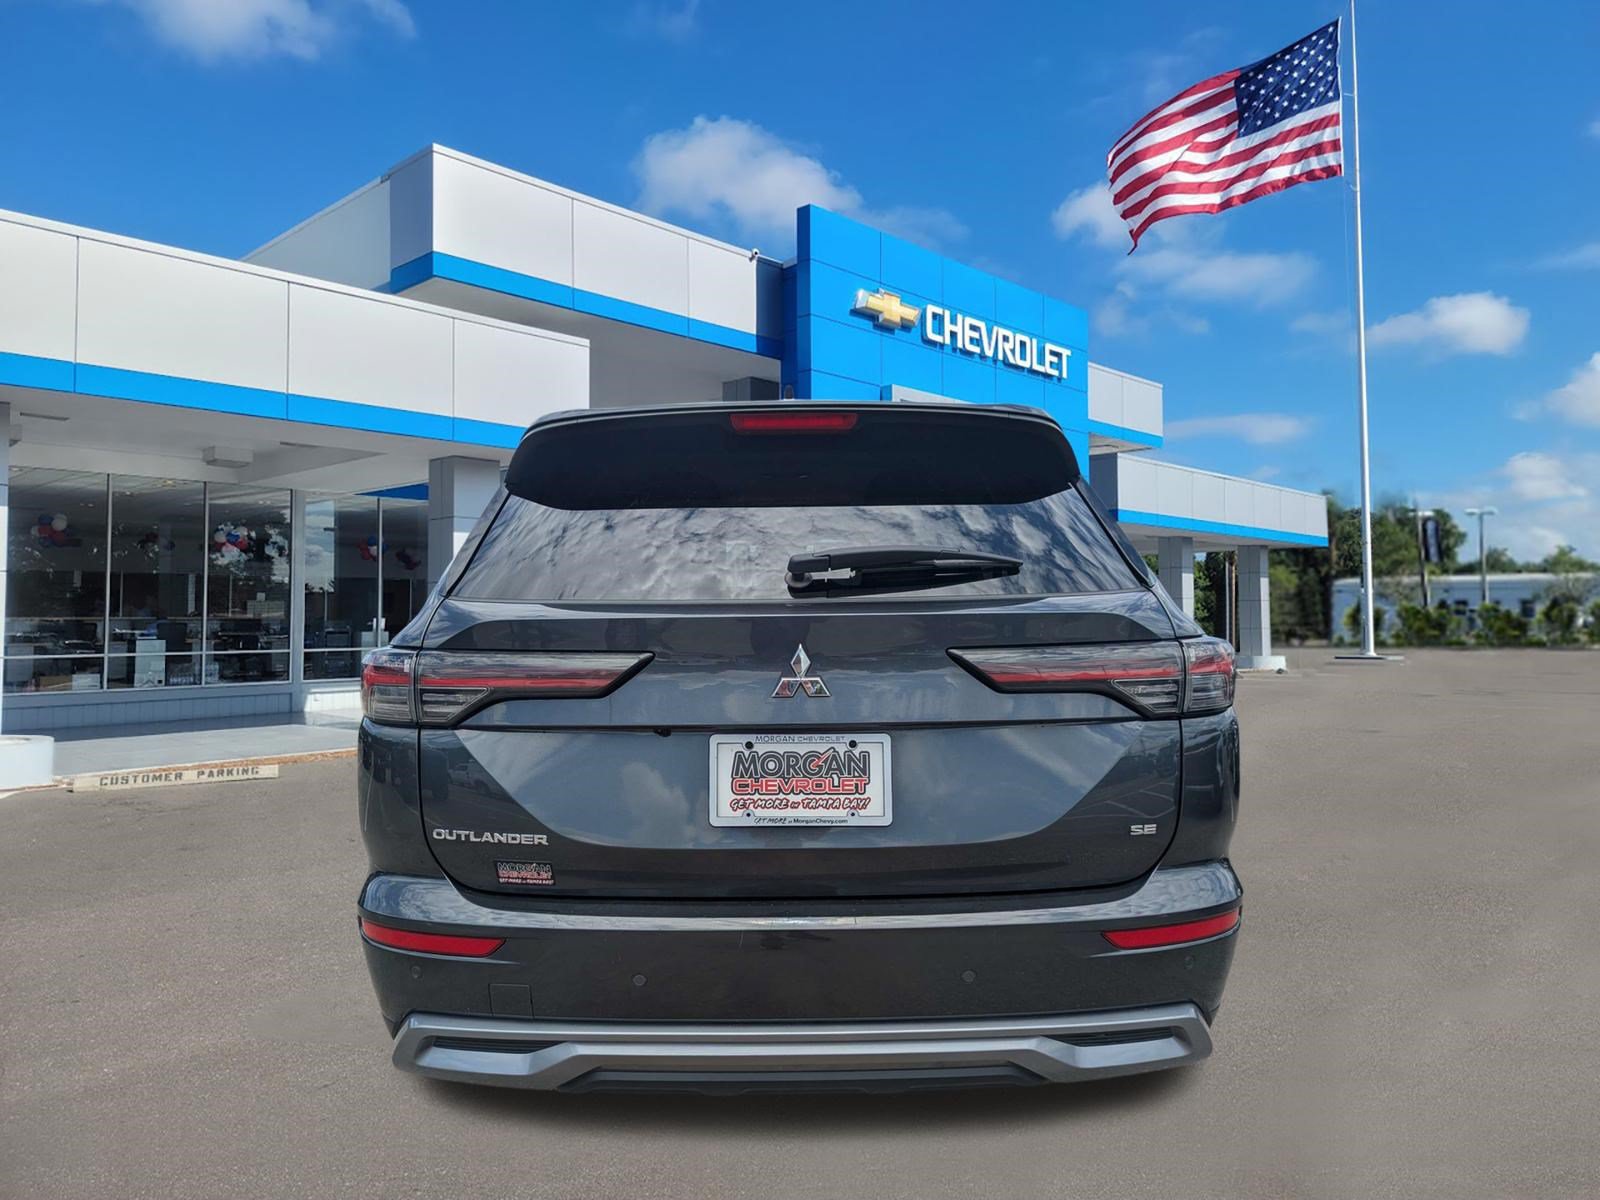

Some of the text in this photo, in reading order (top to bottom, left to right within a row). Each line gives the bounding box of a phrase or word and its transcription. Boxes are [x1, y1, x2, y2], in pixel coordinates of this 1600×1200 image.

[926, 303, 1072, 379] CHEVROLET
[732, 747, 870, 778] MORGAN
[100, 766, 259, 786] CUSTOMER PARKING
[731, 776, 870, 795] CHEVROLET
[730, 797, 755, 811] GET
[753, 797, 789, 810] MORE
[801, 797, 841, 810] TAMPA
[842, 797, 871, 810] BAY!
[793, 818, 848, 826] MorganChevy.com
[1130, 824, 1157, 835] SE
[432, 828, 549, 846] OUTLANDER
[497, 862, 551, 872] MORGAN
